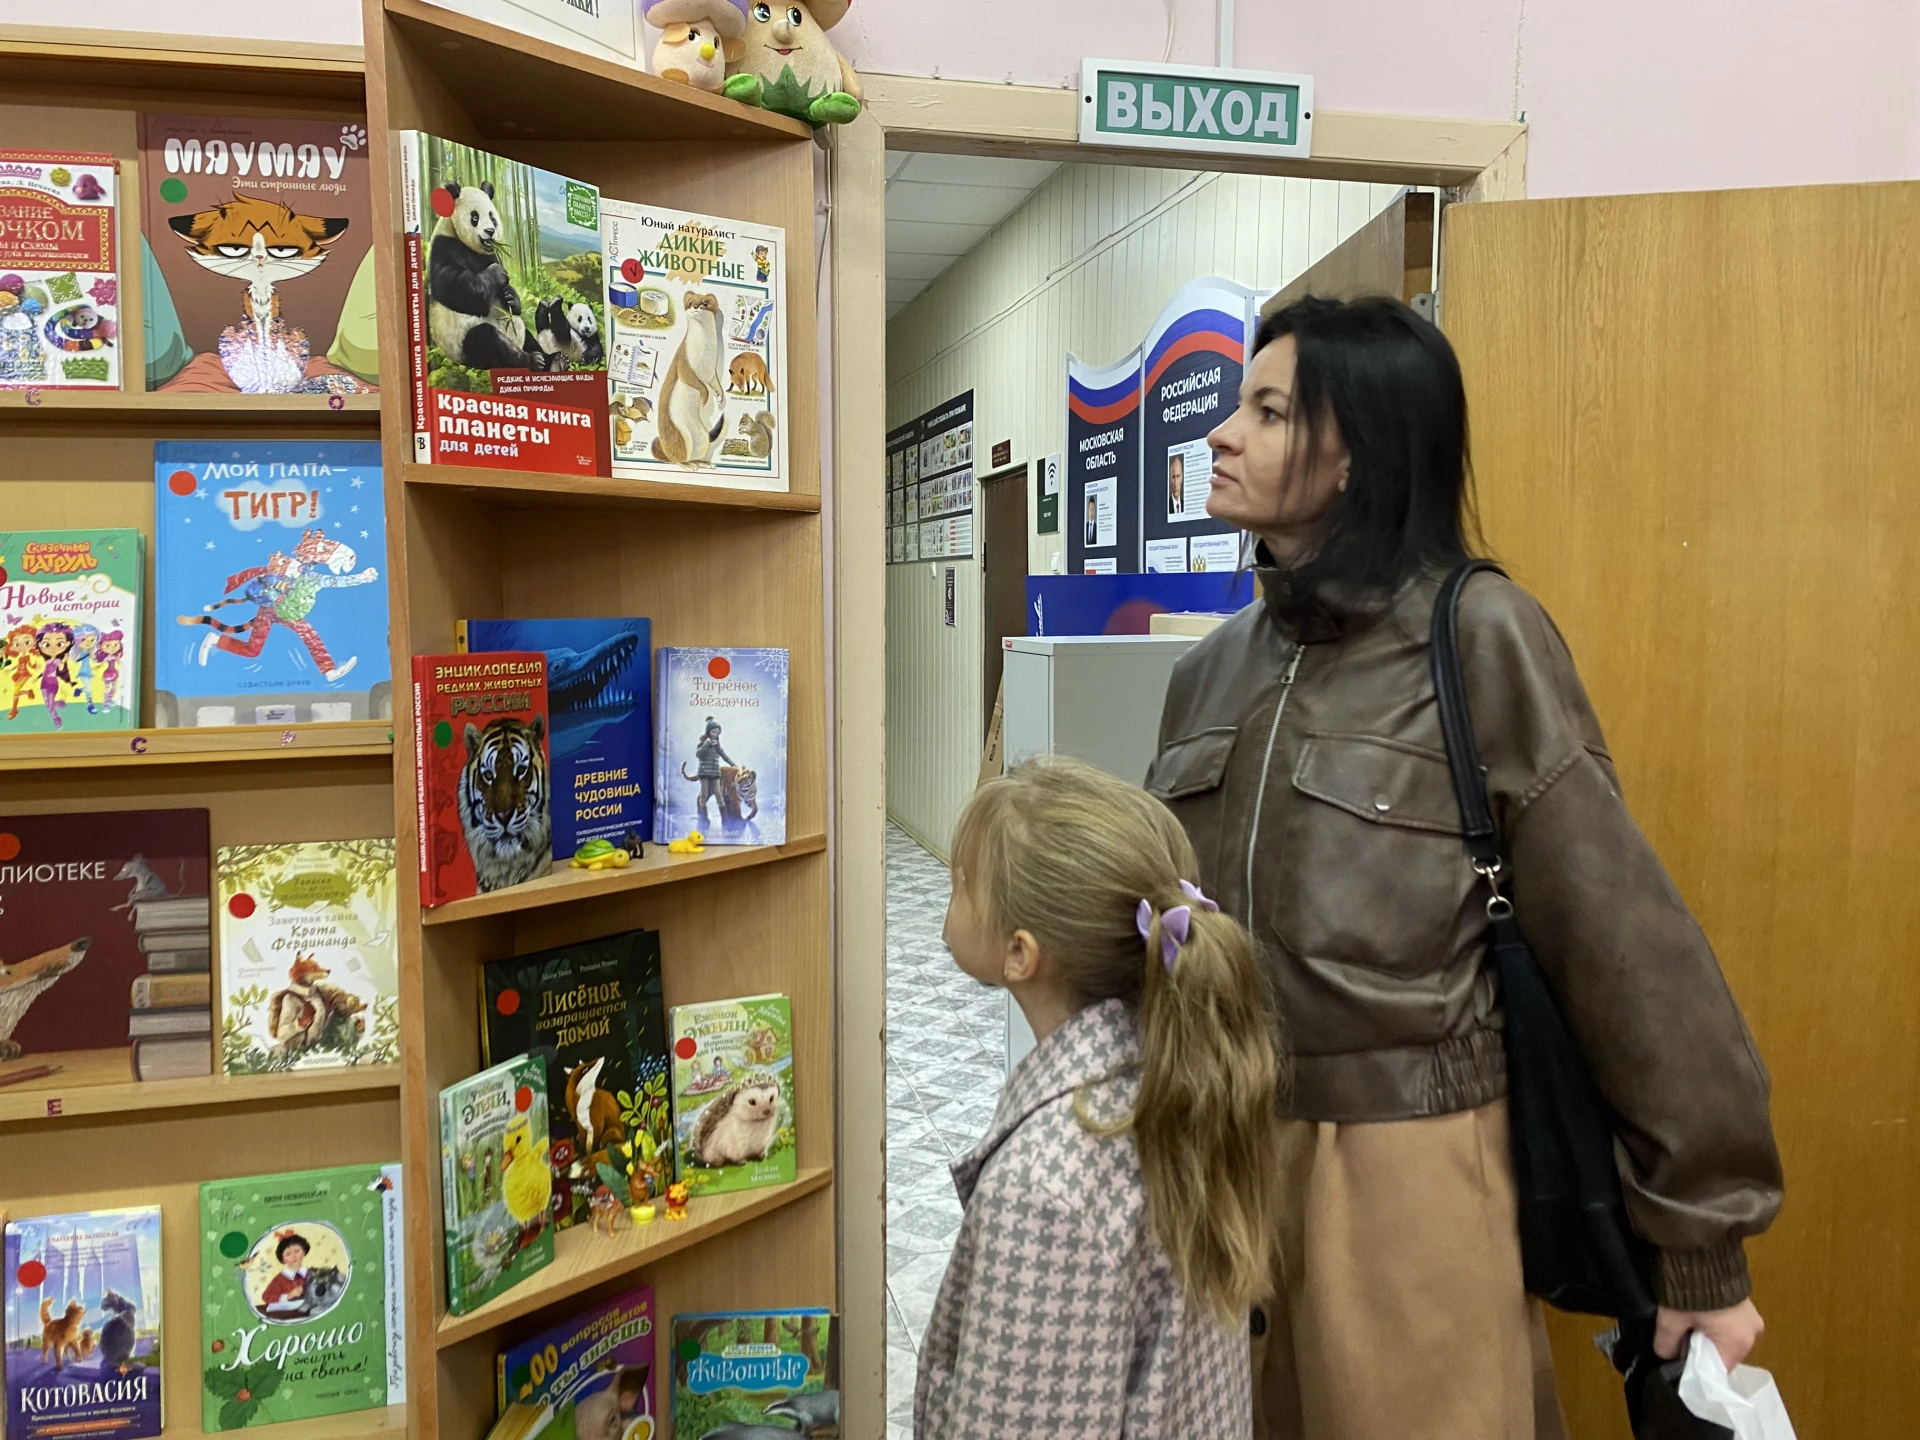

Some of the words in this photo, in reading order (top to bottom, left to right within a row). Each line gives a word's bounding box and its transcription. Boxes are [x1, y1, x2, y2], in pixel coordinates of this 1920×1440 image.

[1106, 80, 1289, 140] ВЫХОД
[164, 137, 347, 180] МЯУМЯУ
[232, 176, 258, 189] Эти
[260, 180, 317, 193] странные
[319, 184, 347, 196] люди
[641, 216, 675, 231] Юный
[678, 224, 736, 240] натуралист
[408, 240, 418, 269] детей
[659, 233, 724, 258] ДИКИЕ
[637, 248, 745, 280] ЖИВОТНЫЕ
[413, 292, 422, 341] планеты
[414, 344, 422, 378] книга
[497, 375, 524, 384] РЕДКИЕ
[532, 374, 574, 383] ИСЧЕЗАЮЩИЕ
[576, 374, 595, 382] ВИДЫ
[499, 385, 522, 394] ДИКОЙ
[523, 384, 554, 393] ПРИРОДЫ
[1161, 366, 1221, 402] РОССИЙСКАЯ
[416, 380, 425, 430] Красная
[536, 407, 592, 428] книга
[1162, 392, 1219, 423] ФЕДЕРАЦИЯ
[438, 415, 551, 445] планеты
[1079, 427, 1124, 453] МОСКОВСКАЯ
[439, 439, 469, 453] для
[474, 443, 519, 458] детей
[1085, 450, 1117, 470] ОБЛАСТЬ
[202, 460, 259, 480] МОЙ
[224, 489, 319, 520] ТИГР!
[25, 540, 91, 554] Сказочный
[21, 552, 98, 575] ПАТРУЛЬ
[0, 584, 75, 610] Новые
[53, 600, 120, 614] истории
[435, 661, 543, 680] ЭНЦИКЛОПЕДИЯ
[436, 681, 481, 694] РЕДКИХ
[483, 677, 543, 691] ЖИВОТНЫХ
[693, 676, 758, 694] Тигрёнок
[414, 682, 422, 717] РОССИИ
[450, 691, 532, 717] РОССИИ
[689, 692, 760, 708] Звёздочка
[417, 768, 425, 803] РЕДКИХ
[574, 767, 629, 789] ДРЕВНИЕ
[575, 783, 642, 803] ЧУДОВИЩА
[575, 803, 623, 822] РОССИИ
[271, 936, 357, 951] Фердинанда
[290, 925, 337, 938] Крота
[535, 1000, 627, 1032] возвращается
[601, 1301, 647, 1333] ответов
[561, 1307, 620, 1353] вопросов
[220, 1322, 363, 1371] Хорошо
[294, 1351, 347, 1366] жить
[551, 1362, 579, 1395] ты
[579, 1316, 652, 1370] знаешь
[285, 1372, 306, 1382] на
[311, 1355, 369, 1380] свете!
[691, 1358, 801, 1382] Животные
[21, 1376, 148, 1413] КОТОВАСИЯ
